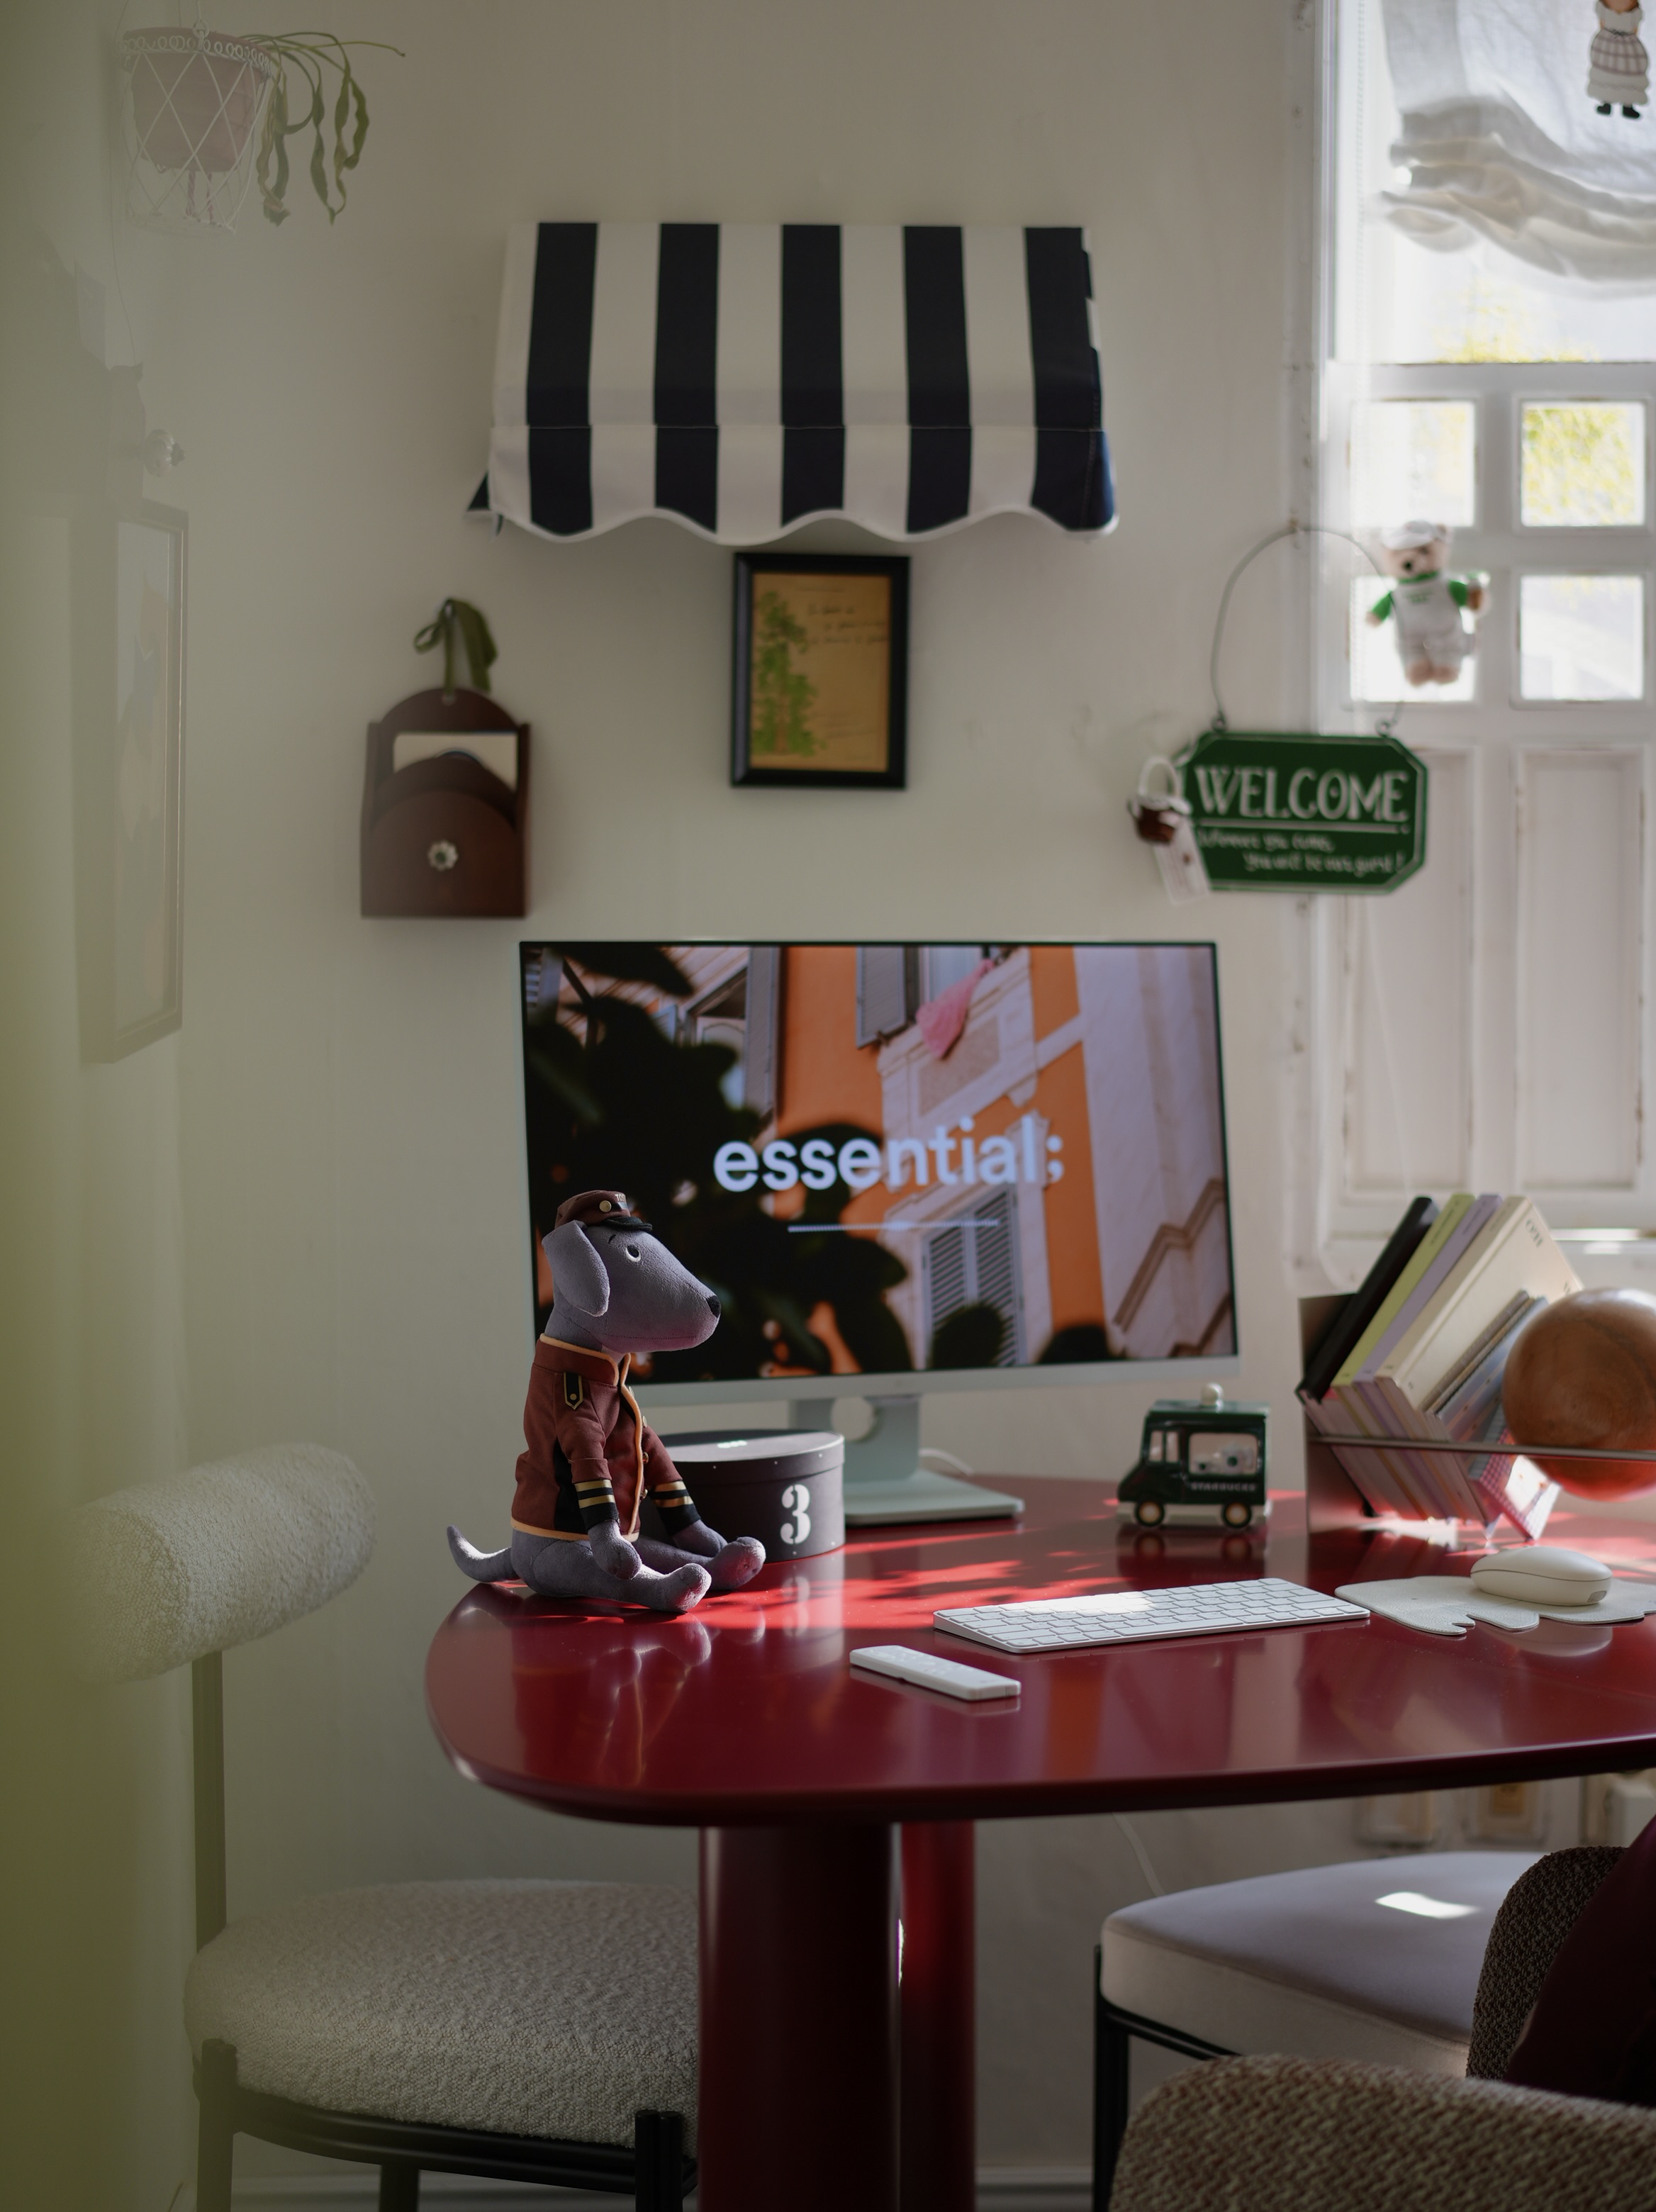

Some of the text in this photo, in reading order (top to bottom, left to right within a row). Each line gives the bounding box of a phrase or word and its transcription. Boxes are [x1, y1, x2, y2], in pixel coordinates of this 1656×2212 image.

[1195, 766, 1409, 822] WELCOME
[712, 1115, 1065, 1192] essential;
[781, 1484, 812, 1545] 3
